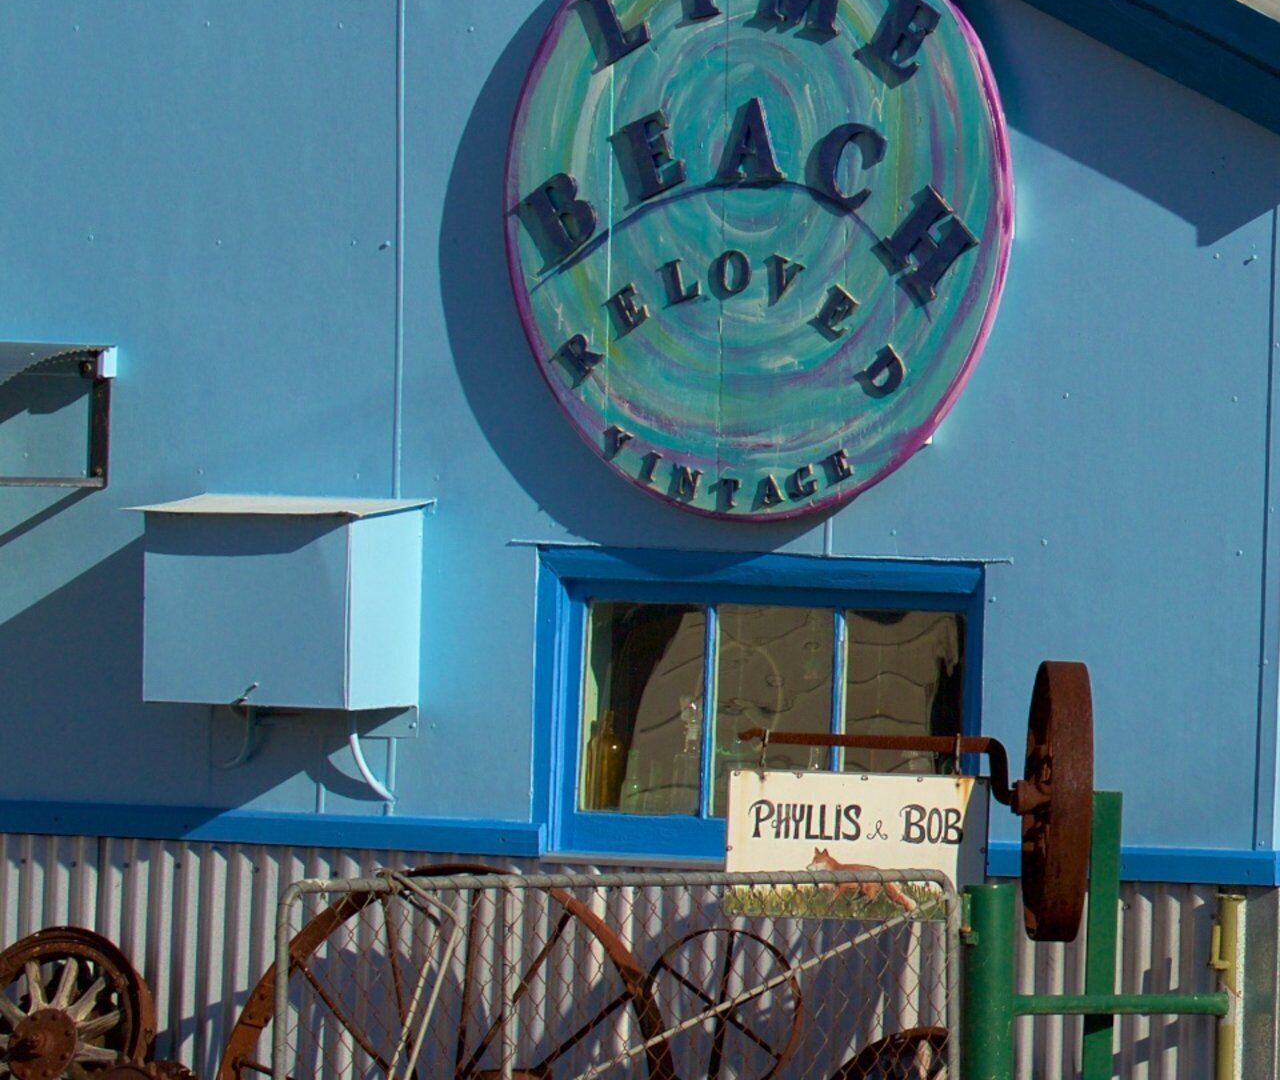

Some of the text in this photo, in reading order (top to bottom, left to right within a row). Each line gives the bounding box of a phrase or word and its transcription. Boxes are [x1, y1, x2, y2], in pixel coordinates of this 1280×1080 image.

[510, 97, 980, 304] BEACH
[553, 248, 908, 400] RELOVED
[603, 426, 856, 512] VINTAGE
[748, 799, 863, 841] PHYLLIS
[899, 804, 964, 845] BOB
